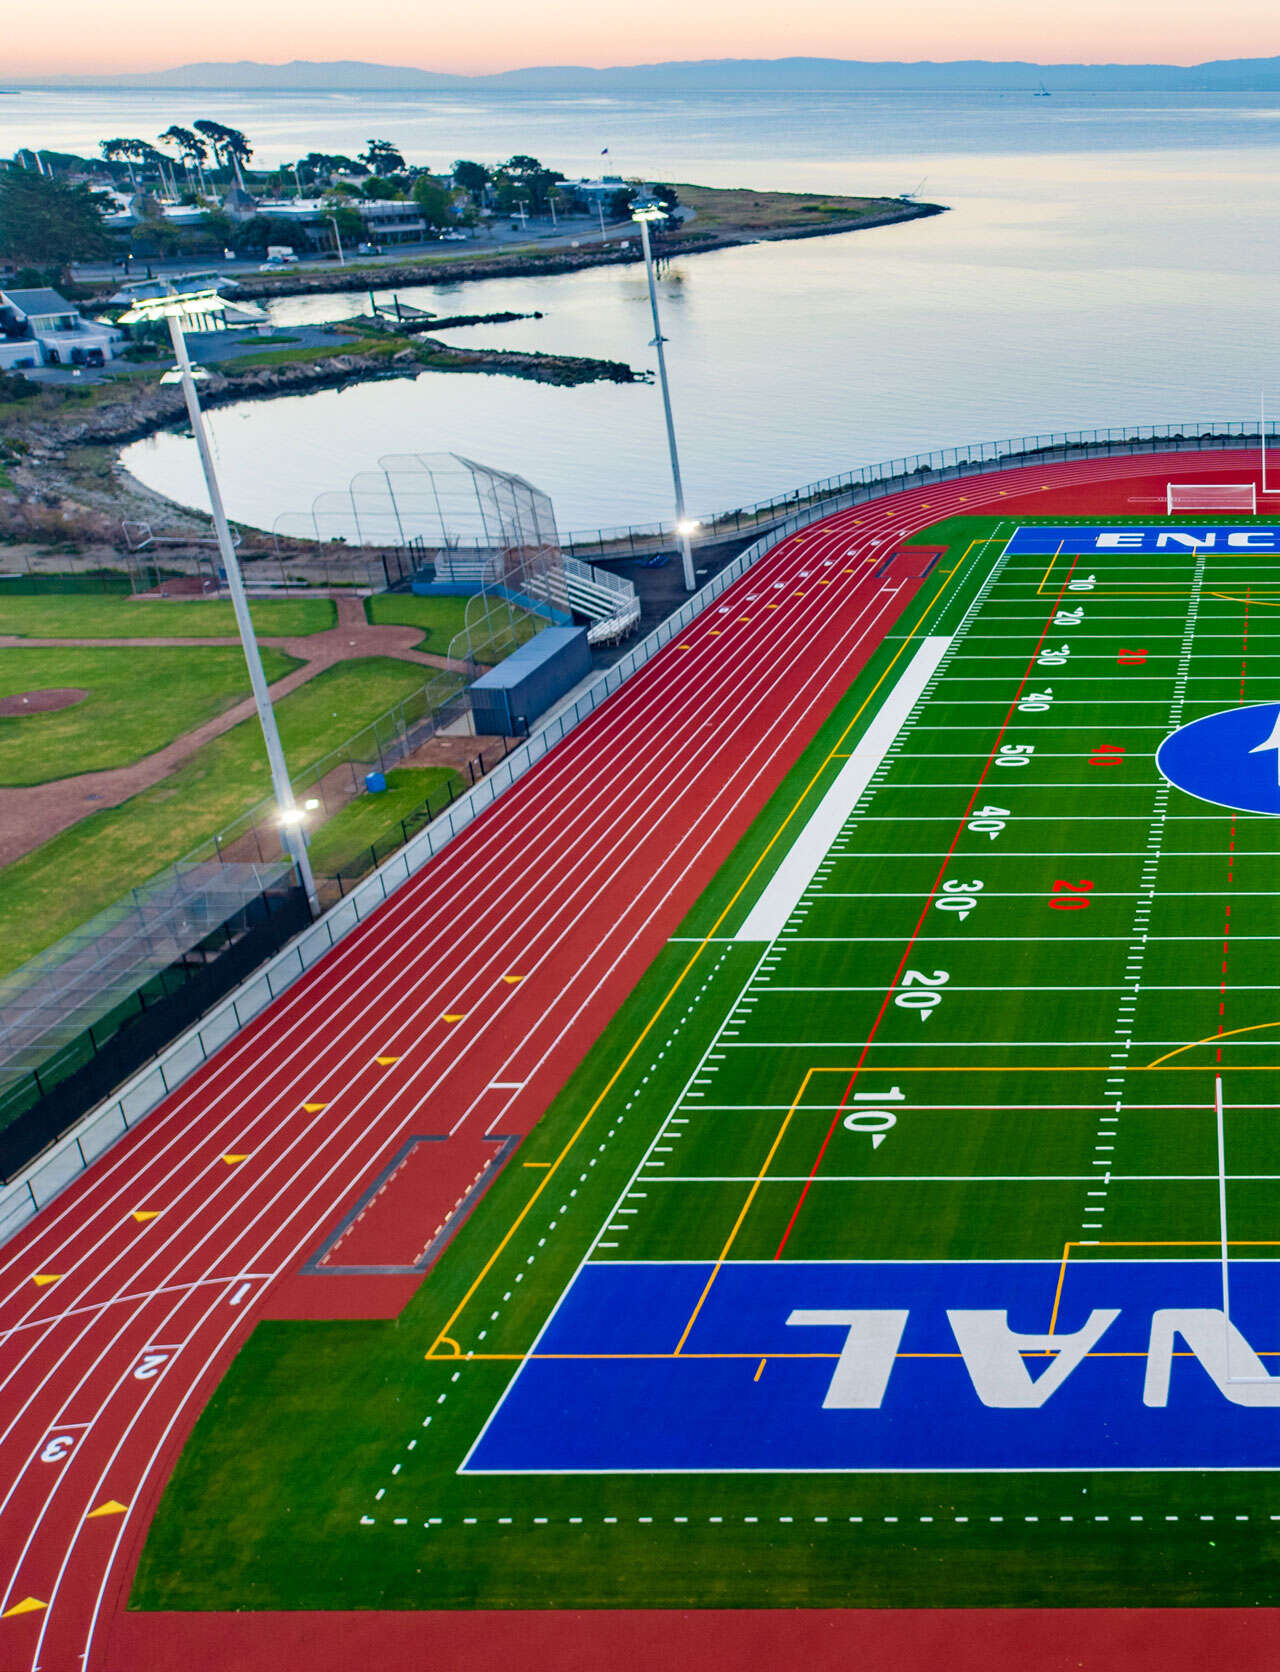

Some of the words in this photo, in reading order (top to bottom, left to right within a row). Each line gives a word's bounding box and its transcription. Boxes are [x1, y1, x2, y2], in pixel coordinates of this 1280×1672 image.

[1068, 577, 1096, 590] 10
[1053, 611, 1084, 625] 20
[1037, 649, 1070, 665] 30
[1116, 649, 1149, 665] 20
[1018, 693, 1053, 712] 40
[995, 744, 1035, 767] 50
[1088, 744, 1126, 766] 40
[967, 806, 1011, 832] 40
[935, 880, 984, 911] 30
[1048, 880, 1094, 910] 20
[894, 970, 950, 1008] 20
[843, 1086, 906, 1132] 10
[229, 1282, 251, 1306] 1
[133, 1353, 169, 1380] 2
[40, 1435, 75, 1463] 3
